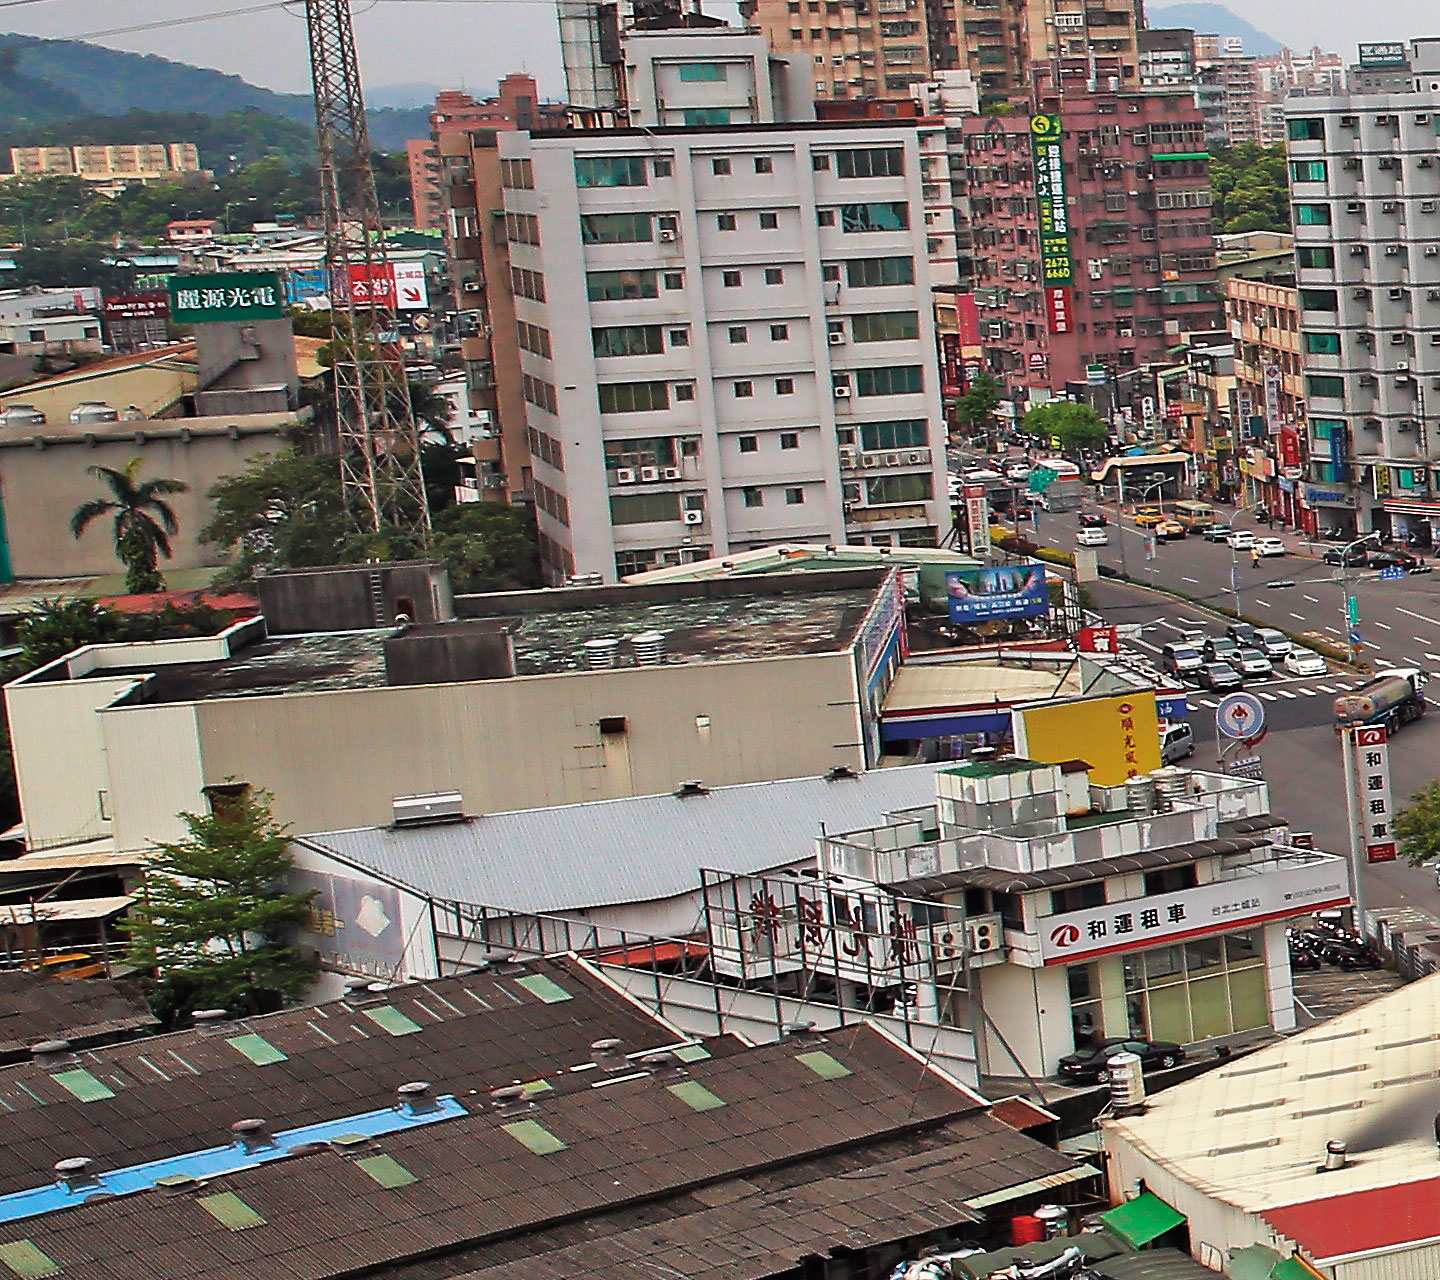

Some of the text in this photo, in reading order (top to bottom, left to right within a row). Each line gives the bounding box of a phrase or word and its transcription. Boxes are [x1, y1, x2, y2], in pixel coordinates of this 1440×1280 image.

[1366, 751, 1388, 839] 和運租車
[1087, 902, 1187, 940] 和運租車
